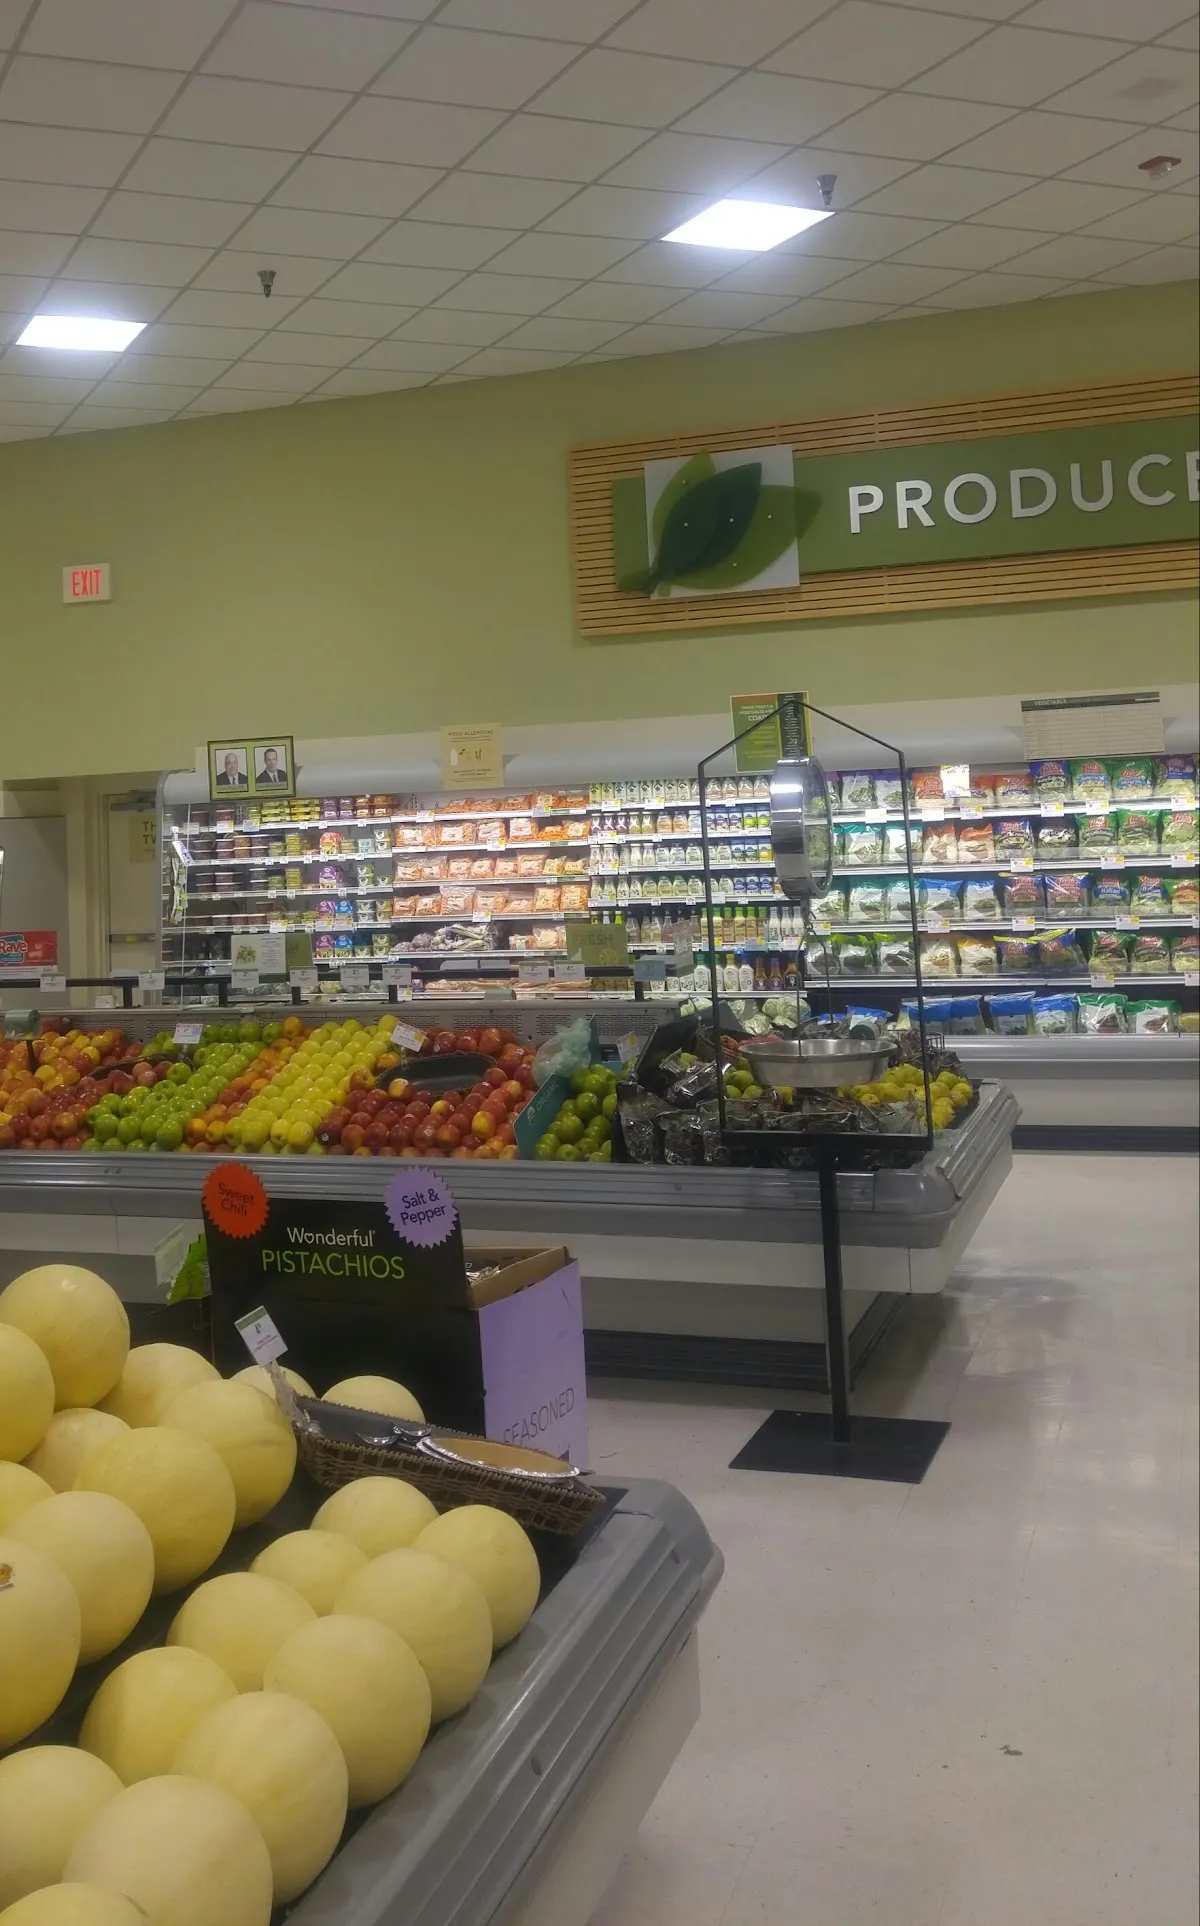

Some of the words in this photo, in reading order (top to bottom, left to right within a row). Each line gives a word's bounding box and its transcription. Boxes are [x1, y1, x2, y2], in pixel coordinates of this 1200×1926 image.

[71, 569, 102, 597] EXIT
[218, 1182, 254, 1205] Sweet
[401, 1191, 427, 1209] Salt
[427, 1188, 440, 1202] &
[220, 1198, 248, 1217] Chili
[400, 1205, 446, 1225] Pepper
[262, 1249, 405, 1280] PISTACHIOS
